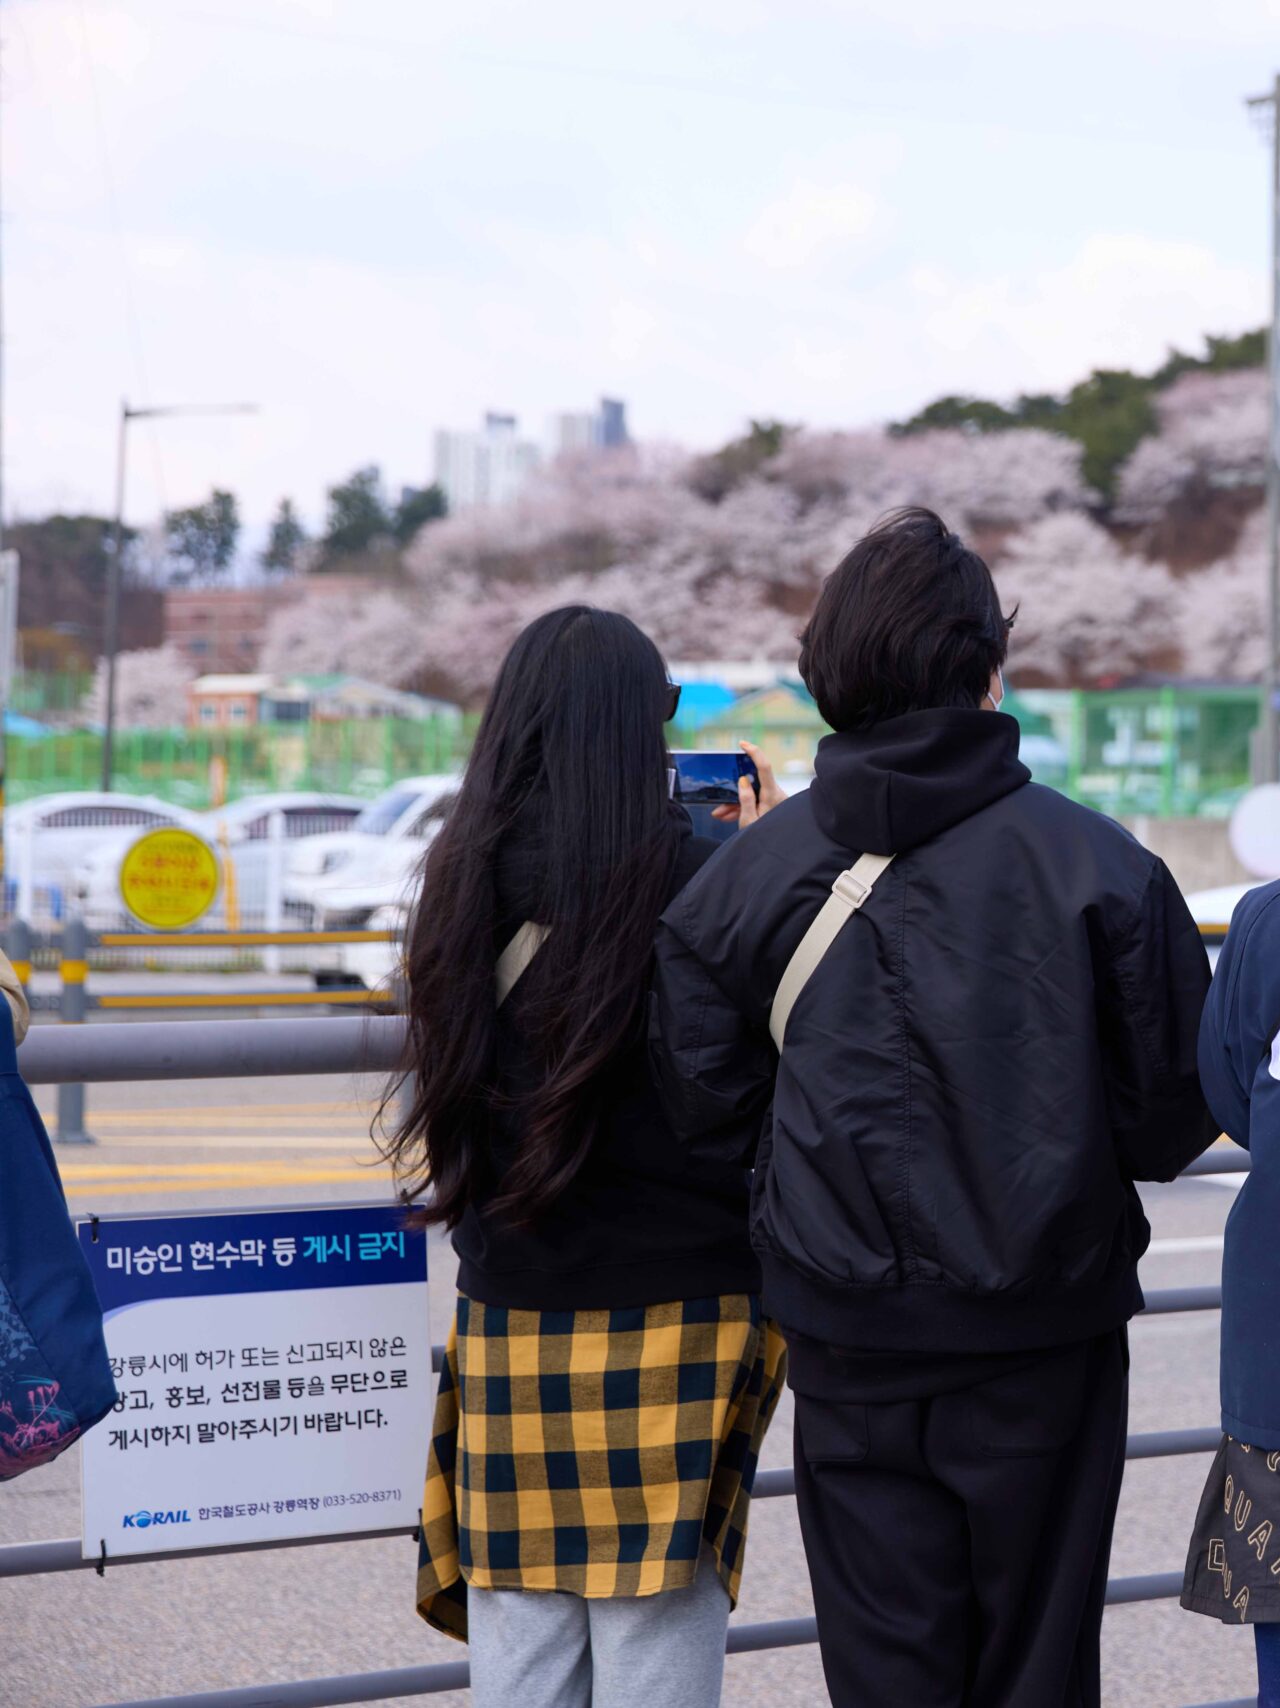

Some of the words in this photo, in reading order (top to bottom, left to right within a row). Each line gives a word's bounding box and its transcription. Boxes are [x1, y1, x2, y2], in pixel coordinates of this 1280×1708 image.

[107, 1244, 183, 1275] 미승인
[190, 1238, 267, 1270] 현수막
[271, 1237, 297, 1267] 등
[303, 1234, 350, 1263] 게시
[358, 1231, 405, 1260] 금지
[108, 1353, 188, 1378] 강릉시에
[195, 1350, 235, 1371] 허가
[241, 1347, 280, 1367] 또는
[286, 1340, 364, 1365] 신고되지
[369, 1336, 407, 1359] 않은
[165, 1385, 211, 1408] 홍보,
[221, 1379, 281, 1404] 선전물
[288, 1376, 325, 1398] 등을
[331, 1369, 408, 1395] 무단으로
[109, 1425, 191, 1450] 게시하지
[197, 1416, 298, 1444] 말아주시기
[304, 1408, 388, 1434] 바랍니다.
[122, 1509, 192, 1528] KORAIL
[198, 1502, 270, 1521] 한국철도공사
[273, 1498, 320, 1515] 강릉역장
[322, 1489, 402, 1508] (033-520-8371)
